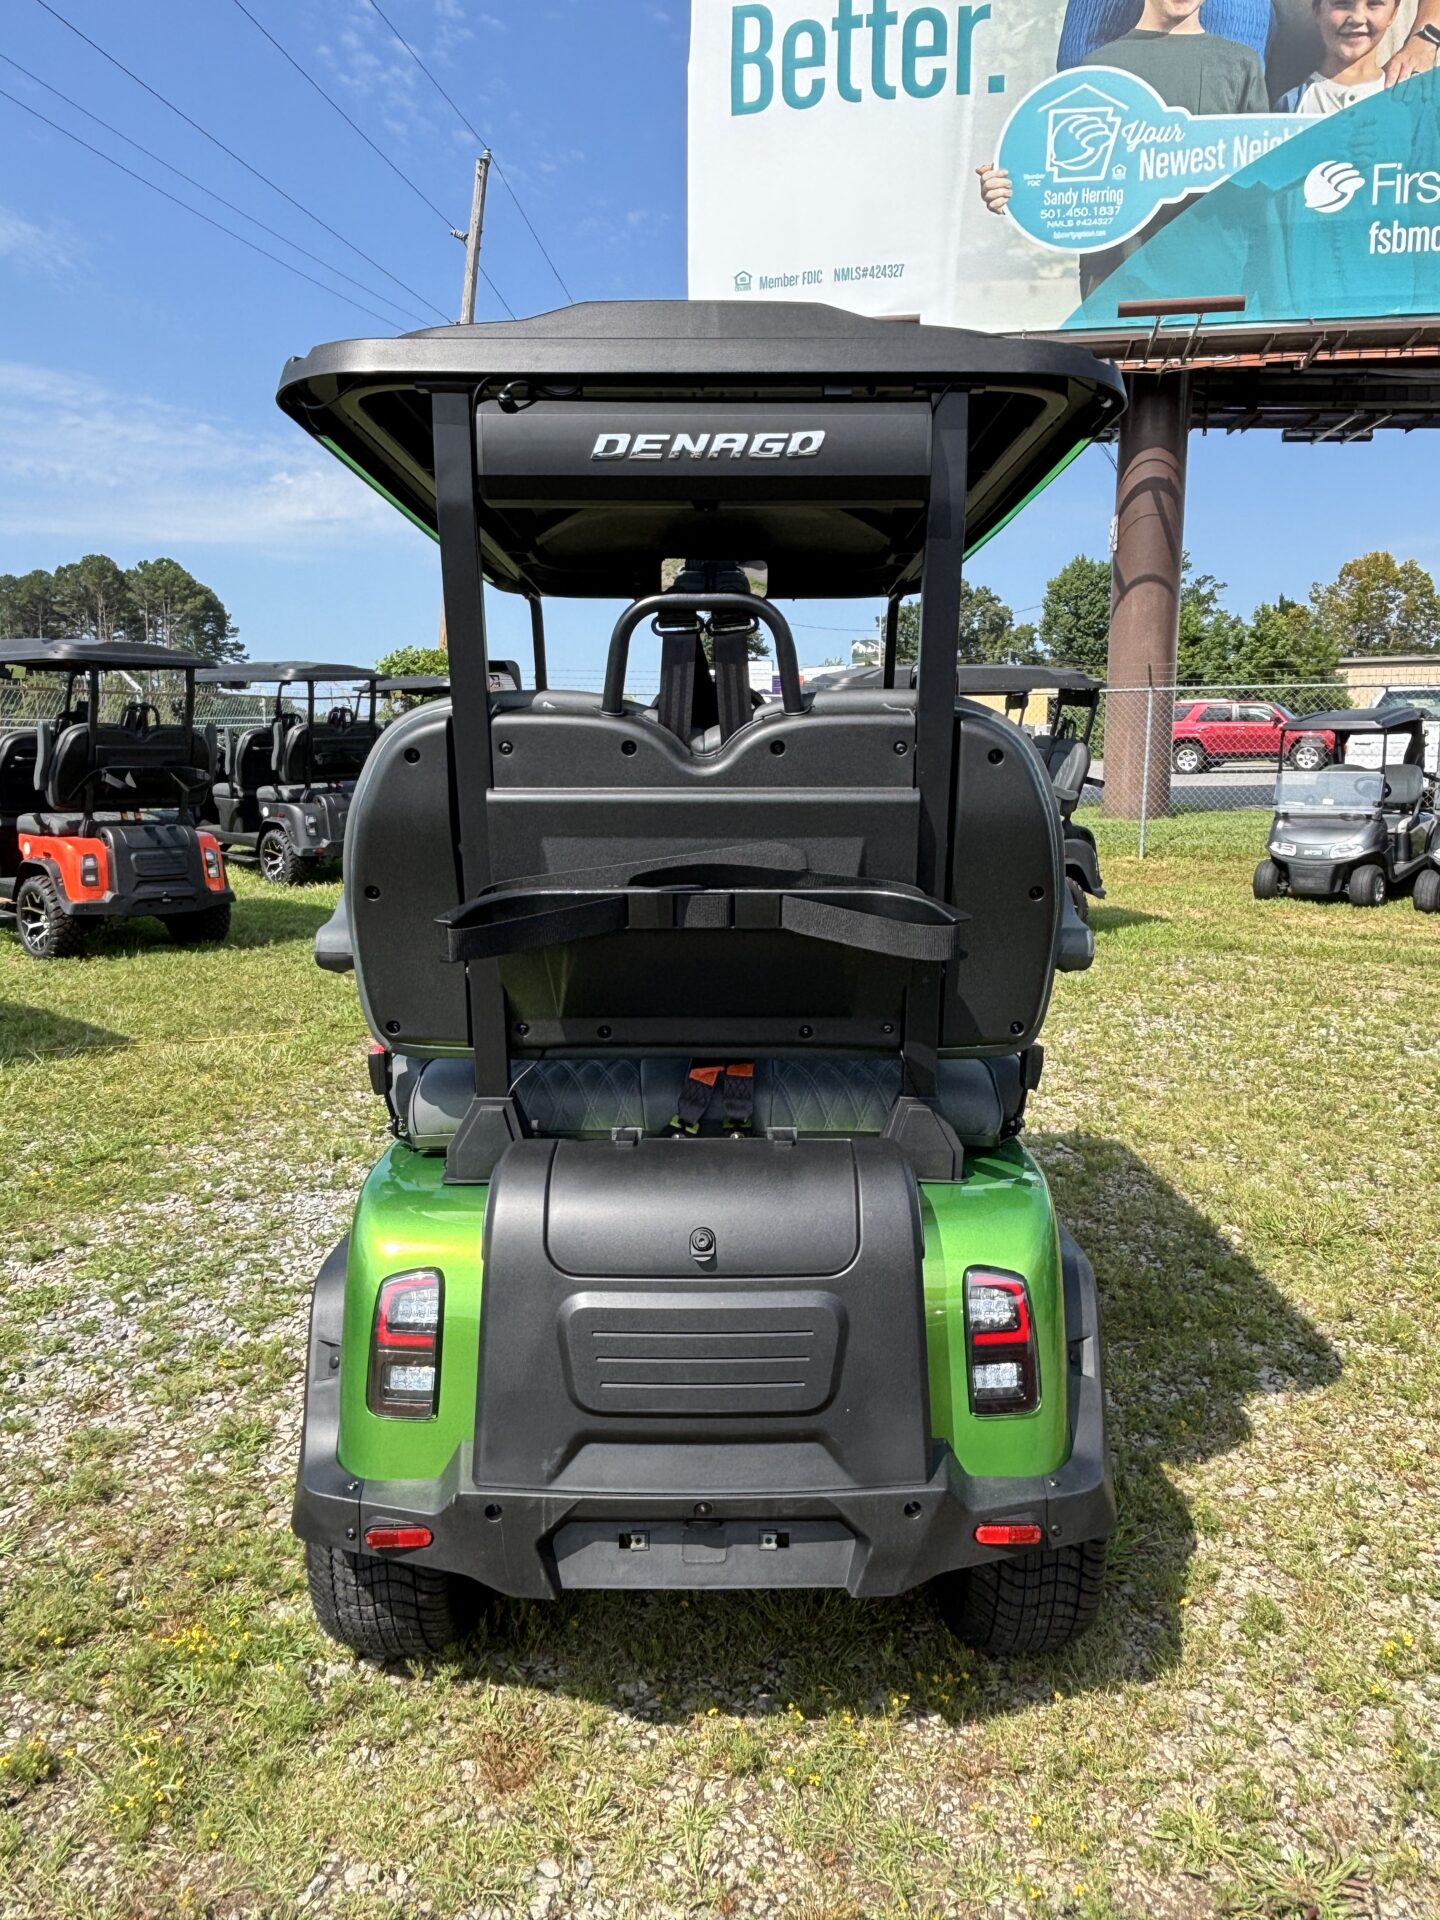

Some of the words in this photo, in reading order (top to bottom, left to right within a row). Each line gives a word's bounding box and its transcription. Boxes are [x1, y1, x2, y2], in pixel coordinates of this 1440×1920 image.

[731, 0, 1005, 116] Better.
[1121, 119, 1186, 152] Your
[1139, 138, 1226, 182] Newest
[1233, 125, 1303, 169] Nei
[1043, 187, 1078, 208] Sandy
[1081, 186, 1124, 205] Herring
[1371, 162, 1440, 206] Firs
[1040, 205, 1121, 219] 501.450.1837
[759, 274, 800, 290] Member
[802, 269, 823, 286] FDIC
[833, 263, 905, 283] NMLS#424327
[590, 430, 826, 460] DENAGO
